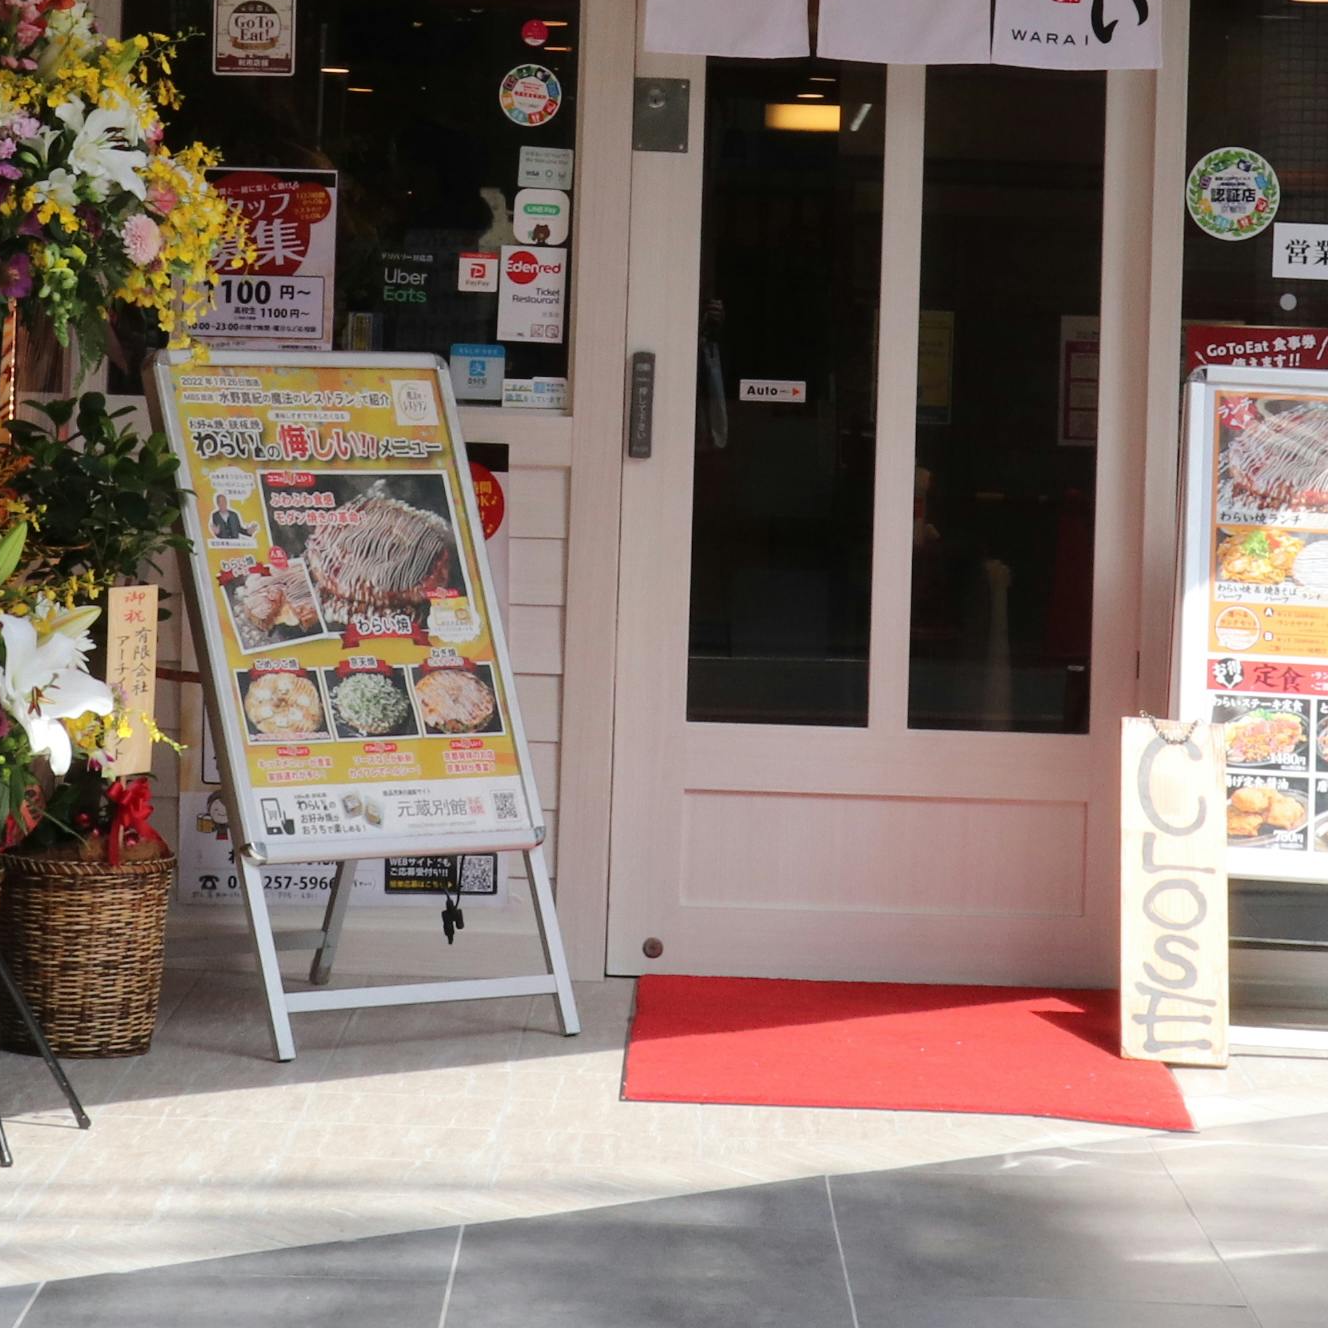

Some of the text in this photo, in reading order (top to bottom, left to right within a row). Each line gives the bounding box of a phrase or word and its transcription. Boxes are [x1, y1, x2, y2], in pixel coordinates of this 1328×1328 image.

[240, 28, 272, 42] Eat!
[1011, 28, 1089, 46] WARAI
[1210, 188, 1256, 203] 認証店
[227, 192, 290, 220] タッフ
[506, 259, 561, 273] Edenred
[384, 268, 429, 285] Uber
[383, 286, 427, 303] Eats
[512, 295, 560, 305] Restaurant
[536, 287, 560, 296] Ticket
[1272, 334, 1317, 353] 食事券
[747, 385, 778, 396] Auto
[1217, 395, 1254, 419] ランチ
[1220, 512, 1303, 526] わらい焼ランチ
[124, 591, 147, 623] 御祝
[357, 615, 411, 634] わらい焼
[431, 647, 457, 657] ねぎ焼
[131, 626, 152, 697] 有限会社
[1253, 663, 1304, 692] 定食
[397, 798, 468, 818] 元蔵別館
[1133, 737, 1218, 1053] CLOSE
